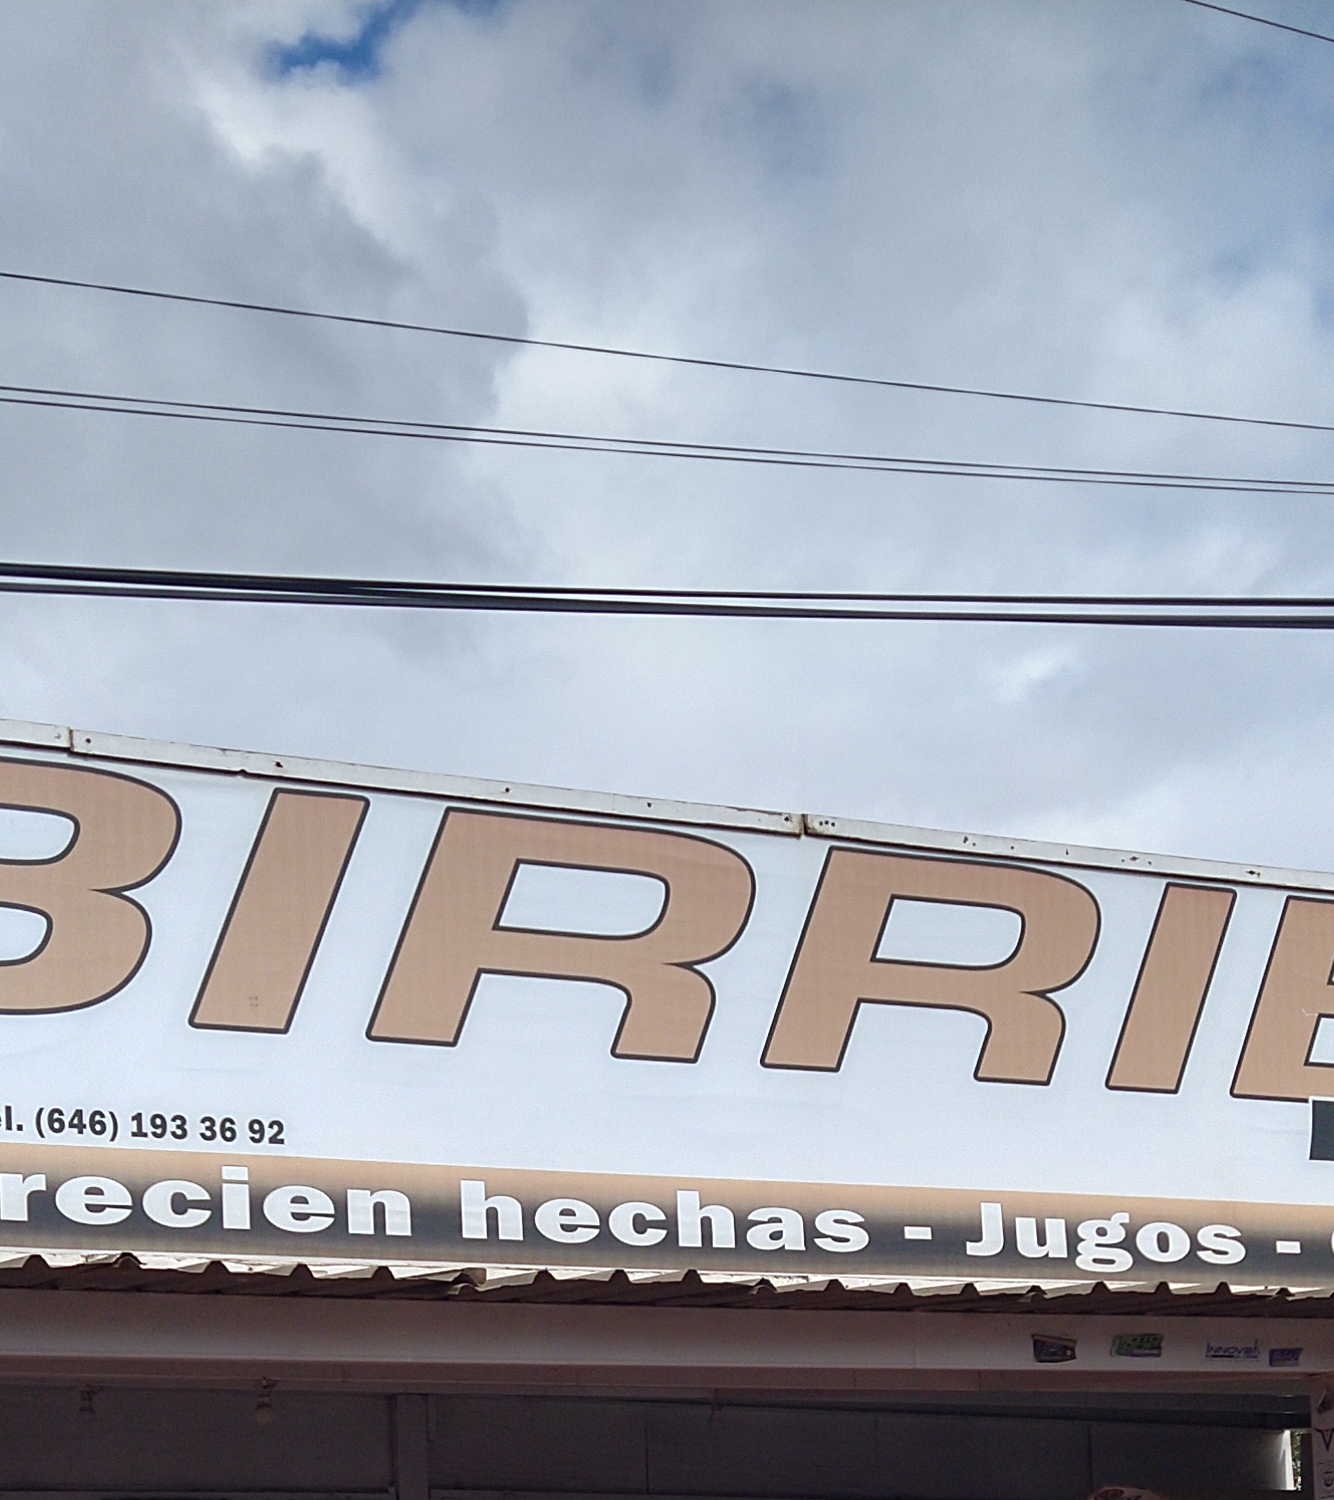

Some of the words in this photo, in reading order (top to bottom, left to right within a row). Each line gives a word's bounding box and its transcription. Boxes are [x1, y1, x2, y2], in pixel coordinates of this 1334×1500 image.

[33, 1106, 120, 1142] (646)
[130, 1112, 188, 1142] 193
[198, 1115, 238, 1144] 36
[247, 1117, 286, 1146] 92
[460, 1180, 870, 1253] hechas
[965, 1203, 1248, 1273] Jugos
